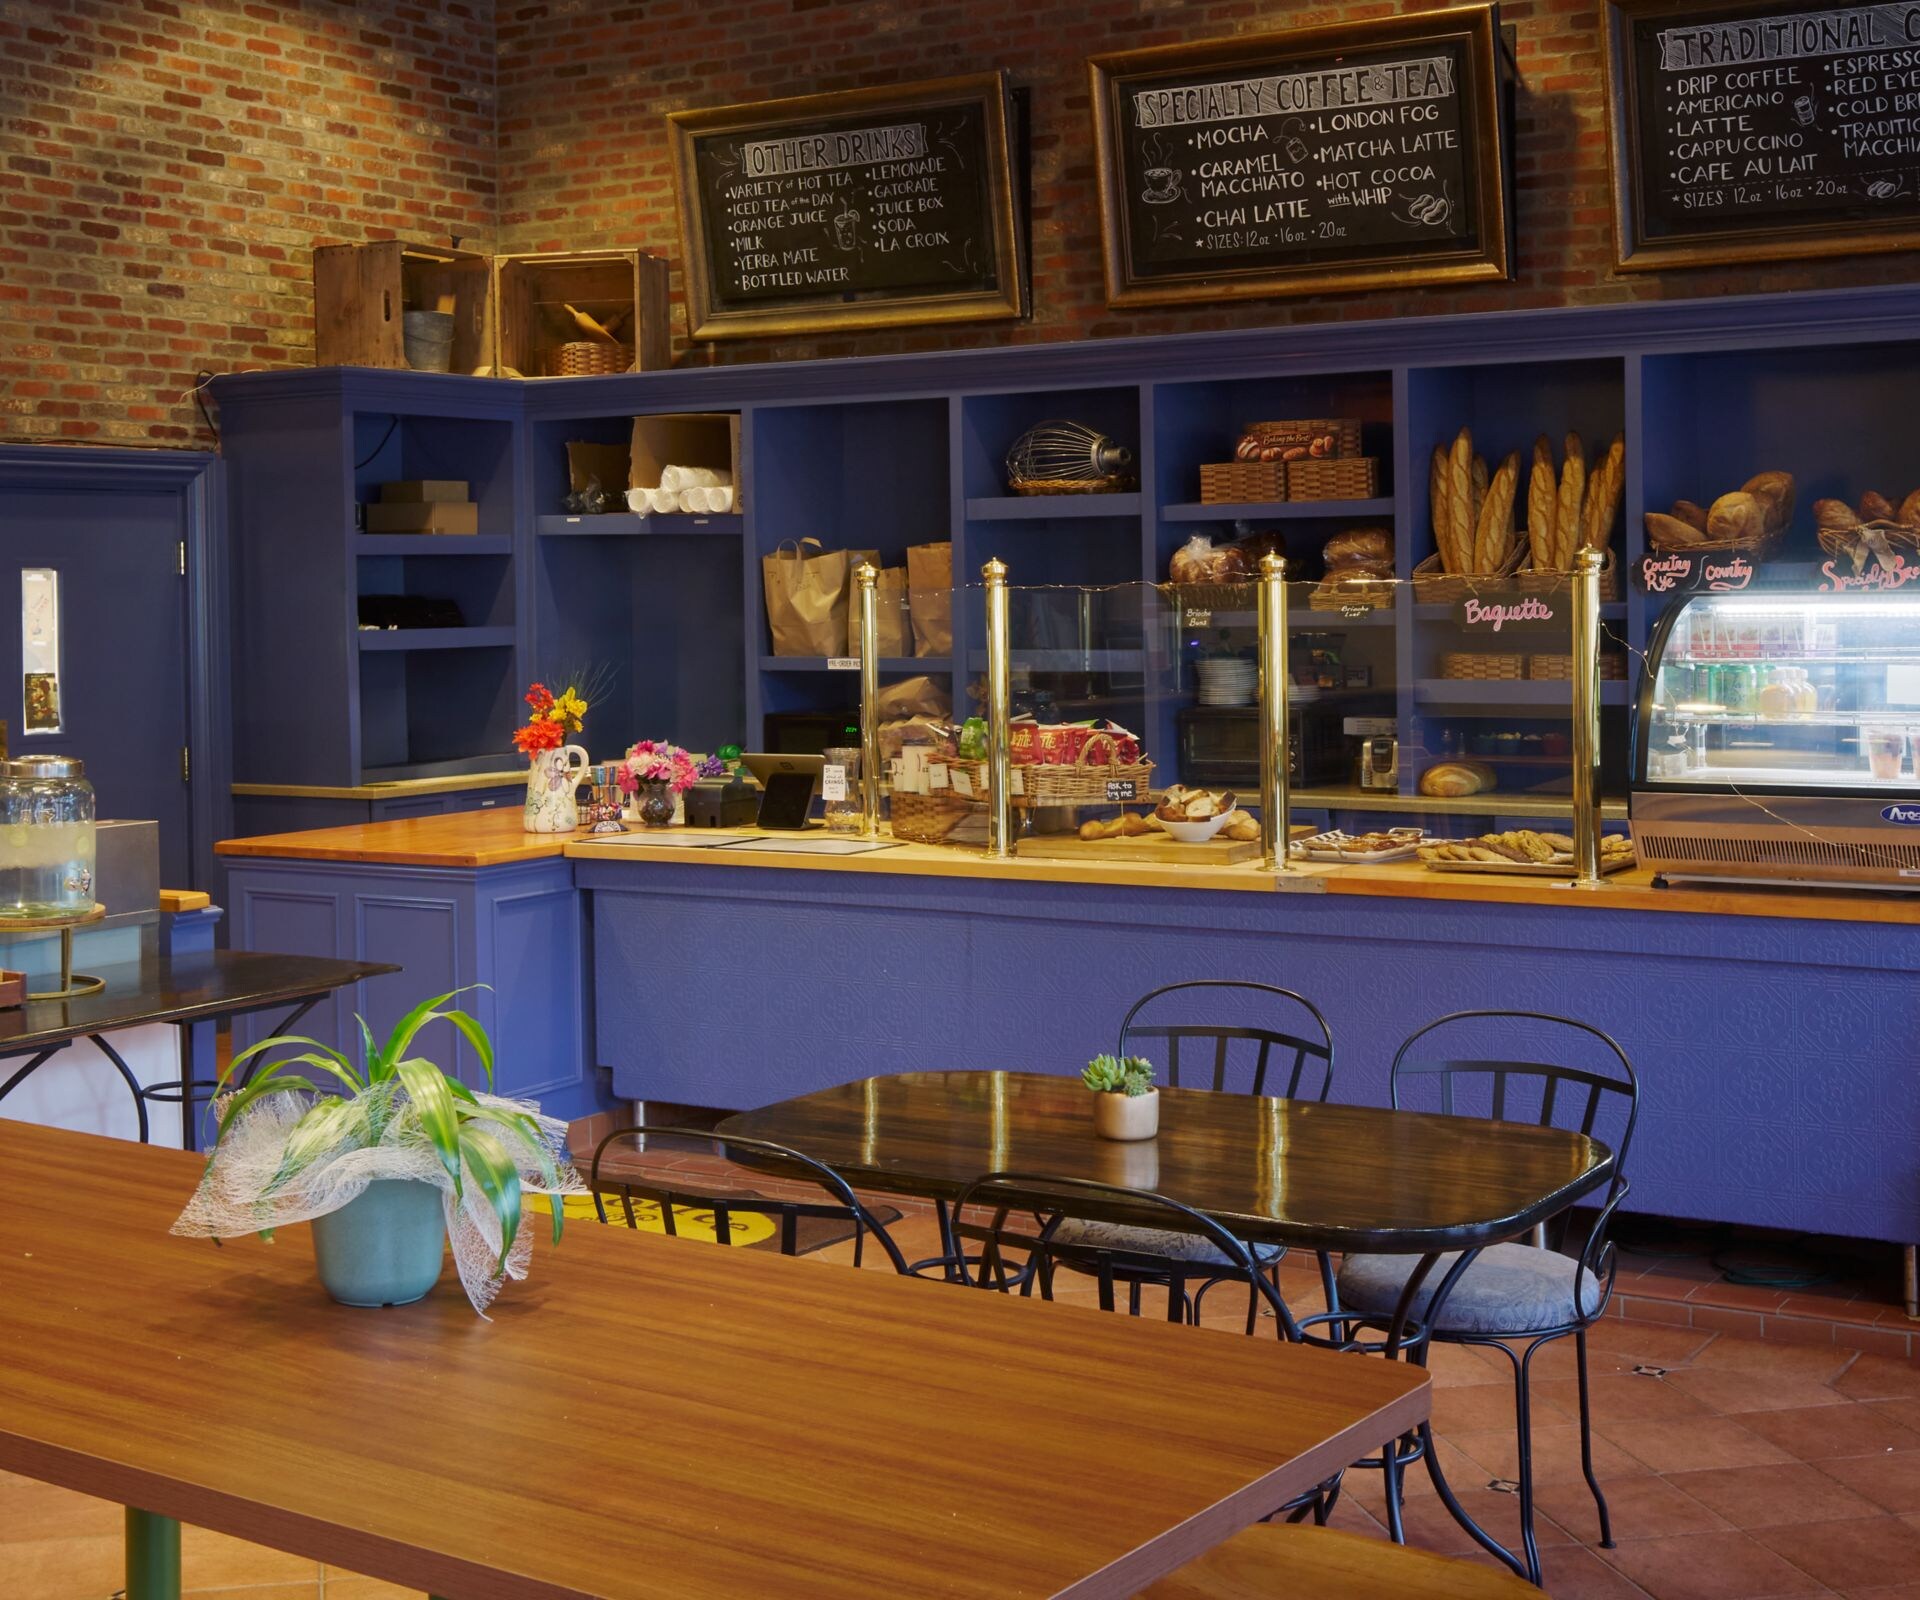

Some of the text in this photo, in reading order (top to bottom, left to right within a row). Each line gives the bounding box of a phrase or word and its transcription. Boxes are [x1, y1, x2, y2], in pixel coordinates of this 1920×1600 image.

[1674, 14, 1885, 67] TRADITIONAL
[1144, 62, 1444, 124] SPECIALTY COFFEE & TEA
[1678, 67, 1802, 95] DRIP COFFEE
[1834, 76, 1877, 95] RED
[1676, 91, 1784, 115] AMERICANO
[1837, 97, 1888, 117] COLD
[1318, 105, 1439, 133] LONDON FOG
[1678, 115, 1753, 136] LATTE
[1197, 124, 1268, 149] MOCHA
[1320, 130, 1457, 163] MATCHA LATTE
[1677, 133, 1803, 160] CAPPUCCINO
[753, 128, 915, 175] OTHER DRINKS
[872, 157, 947, 181] LEMONADE
[1200, 153, 1285, 178] CARAMEL
[1678, 154, 1818, 184] CAFE AU LAIT
[730, 172, 853, 199] VARIETY of HOT TEA
[874, 177, 939, 199] GATORADE
[1201, 172, 1304, 198] MACCHIATO
[1323, 166, 1435, 191] HOT COCOA
[733, 201, 759, 216] ICED
[763, 199, 790, 212] TEA
[812, 192, 834, 206] DAY
[878, 197, 944, 216] JUICE BOX
[1328, 187, 1391, 207] with WHIP
[734, 210, 827, 233] ORANGE JUICE
[1204, 199, 1311, 228] CHAI LATTE
[878, 218, 916, 234] SODA
[736, 236, 764, 252] MILK
[881, 232, 949, 252] LA CROIX
[739, 248, 819, 271] YERBA MATE
[742, 267, 849, 290] BOTTLED WATER
[1464, 598, 1553, 631] Baguette
[1107, 790, 1120, 799] try
